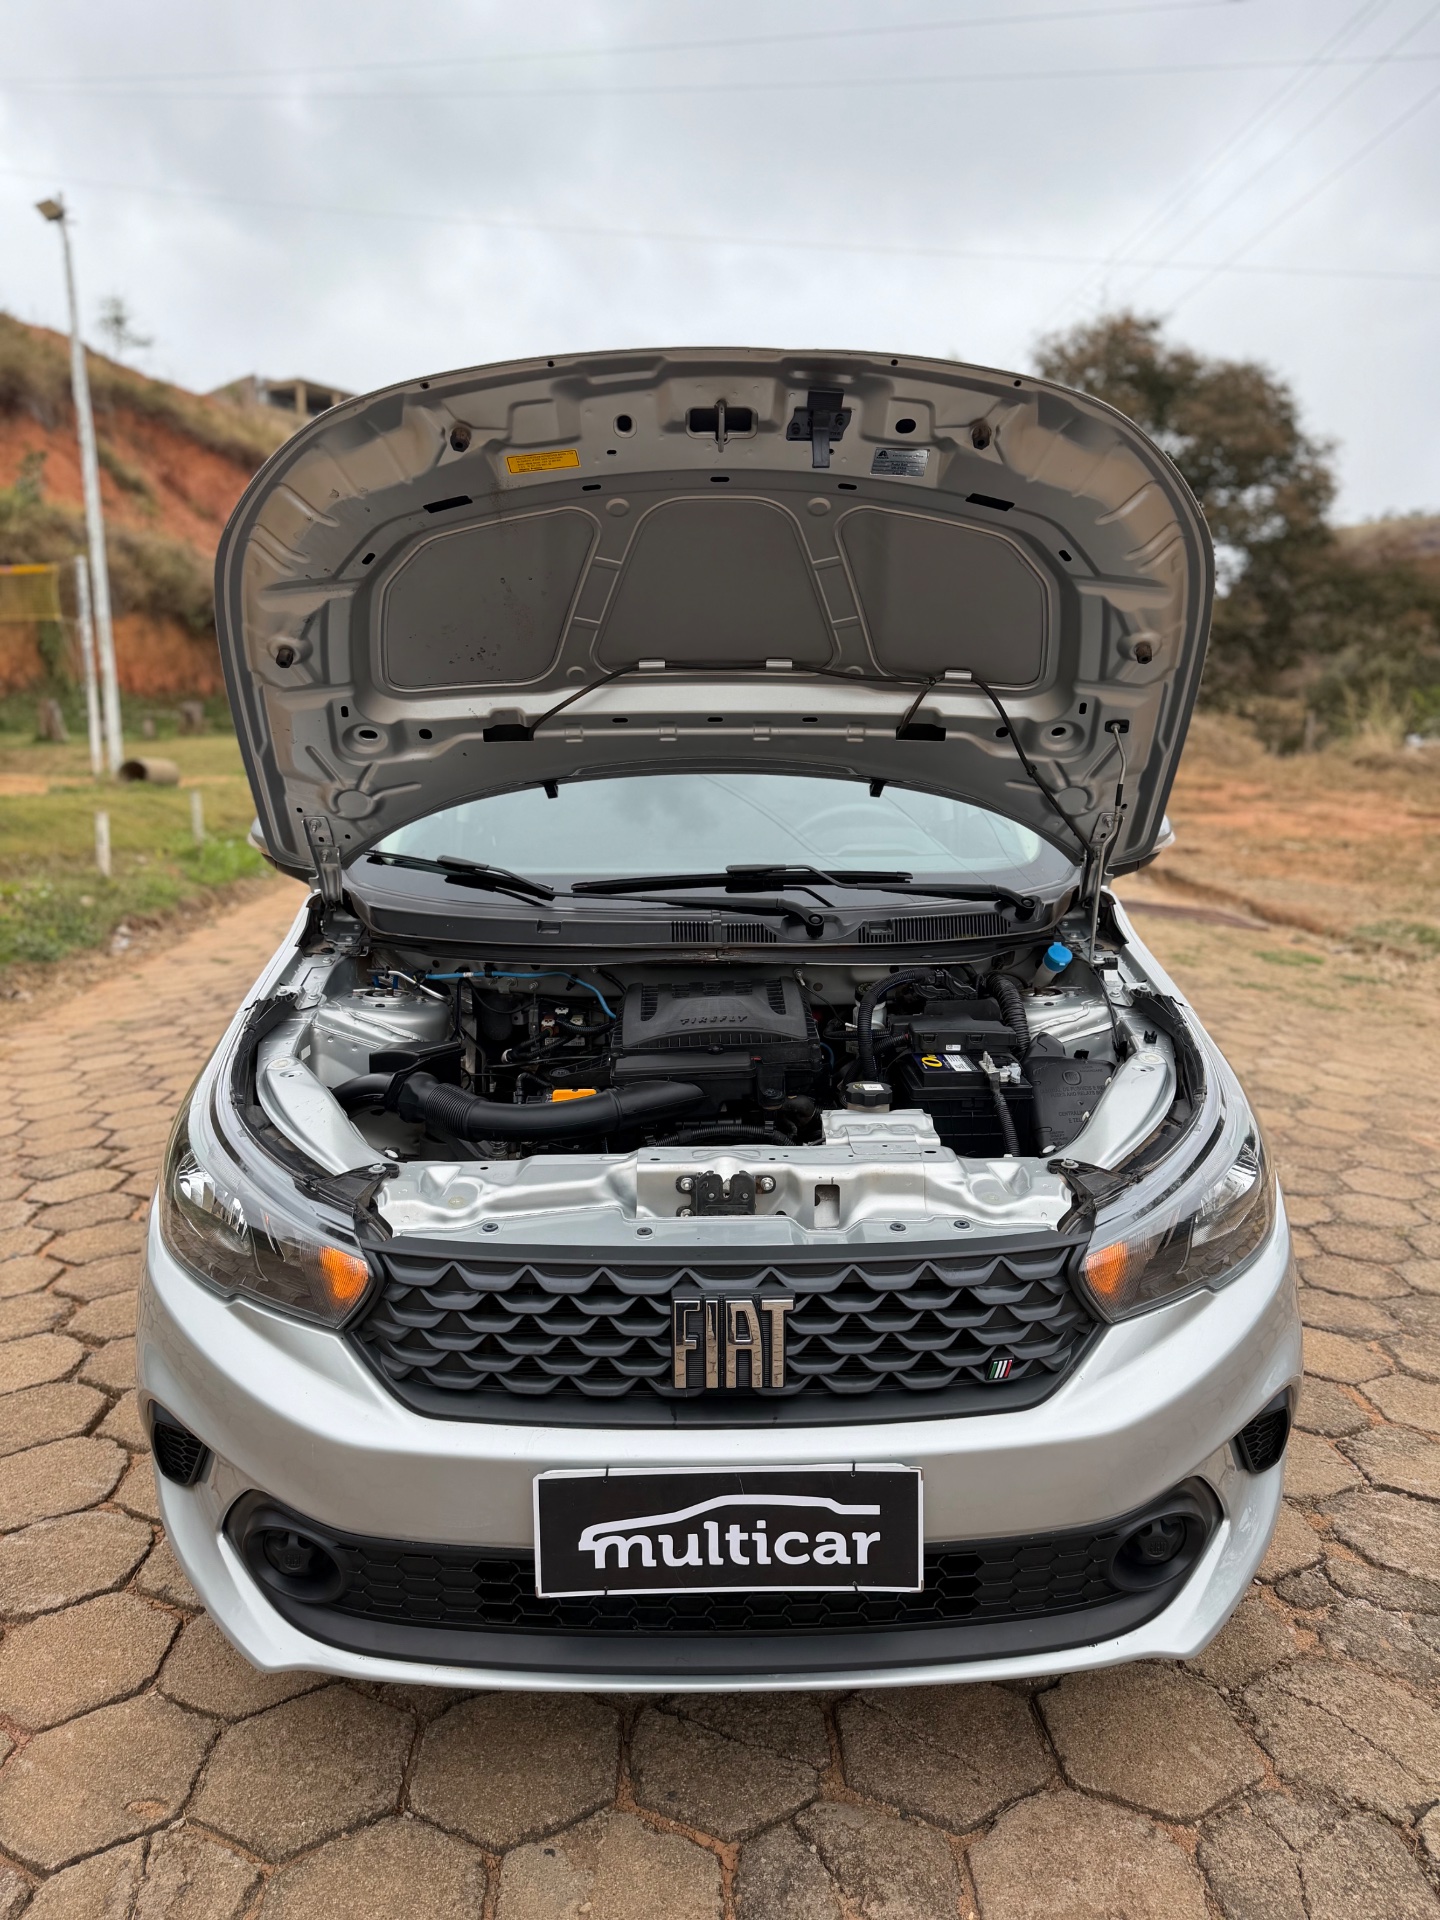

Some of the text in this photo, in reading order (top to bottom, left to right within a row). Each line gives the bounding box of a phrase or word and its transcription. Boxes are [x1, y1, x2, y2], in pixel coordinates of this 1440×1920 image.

[680, 1015, 748, 1026] FIREFLY
[674, 1299, 794, 1388] FIAT
[580, 1520, 881, 1568] multicar
